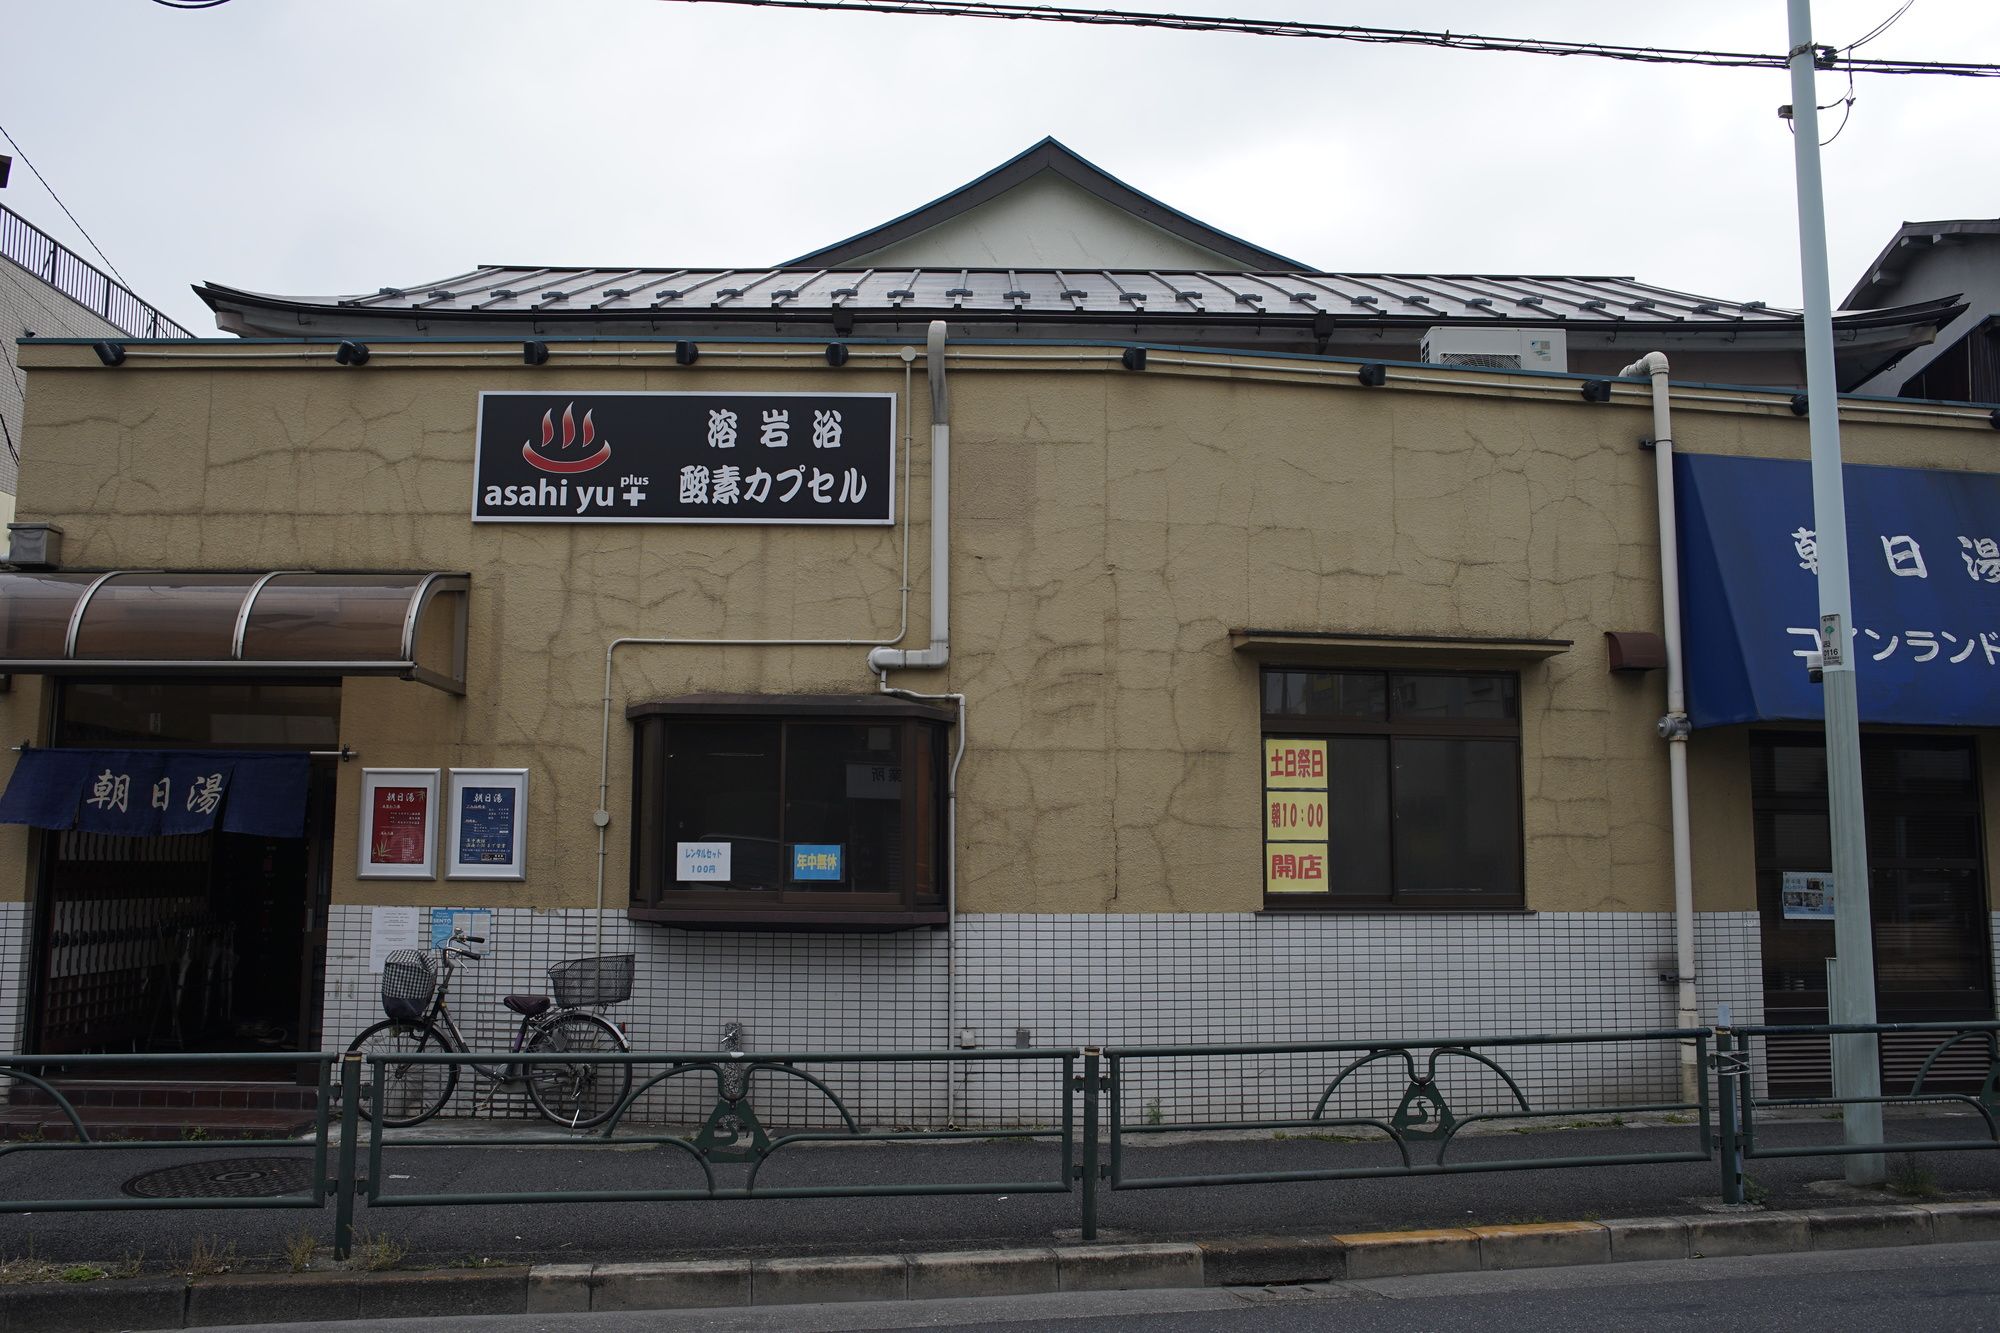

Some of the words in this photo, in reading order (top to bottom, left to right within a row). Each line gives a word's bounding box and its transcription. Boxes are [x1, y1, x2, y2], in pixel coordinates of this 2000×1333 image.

[708, 409, 843, 449] 溶岩浴
[620, 475, 649, 487] plus
[679, 464, 868, 505] 酸素カプセル
[485, 479, 567, 506] asahi
[577, 485, 614, 513] yu
[1786, 627, 2000, 665] コンランド
[1270, 749, 1324, 778] 土日祭日
[87, 769, 223, 814] 朝日湯
[473, 793, 503, 803] 朝日湯
[685, 848, 723, 859] レンタルセット
[796, 853, 837, 871] 年中無休
[1271, 854, 1323, 880] 開店
[691, 865, 716, 874] 100円
